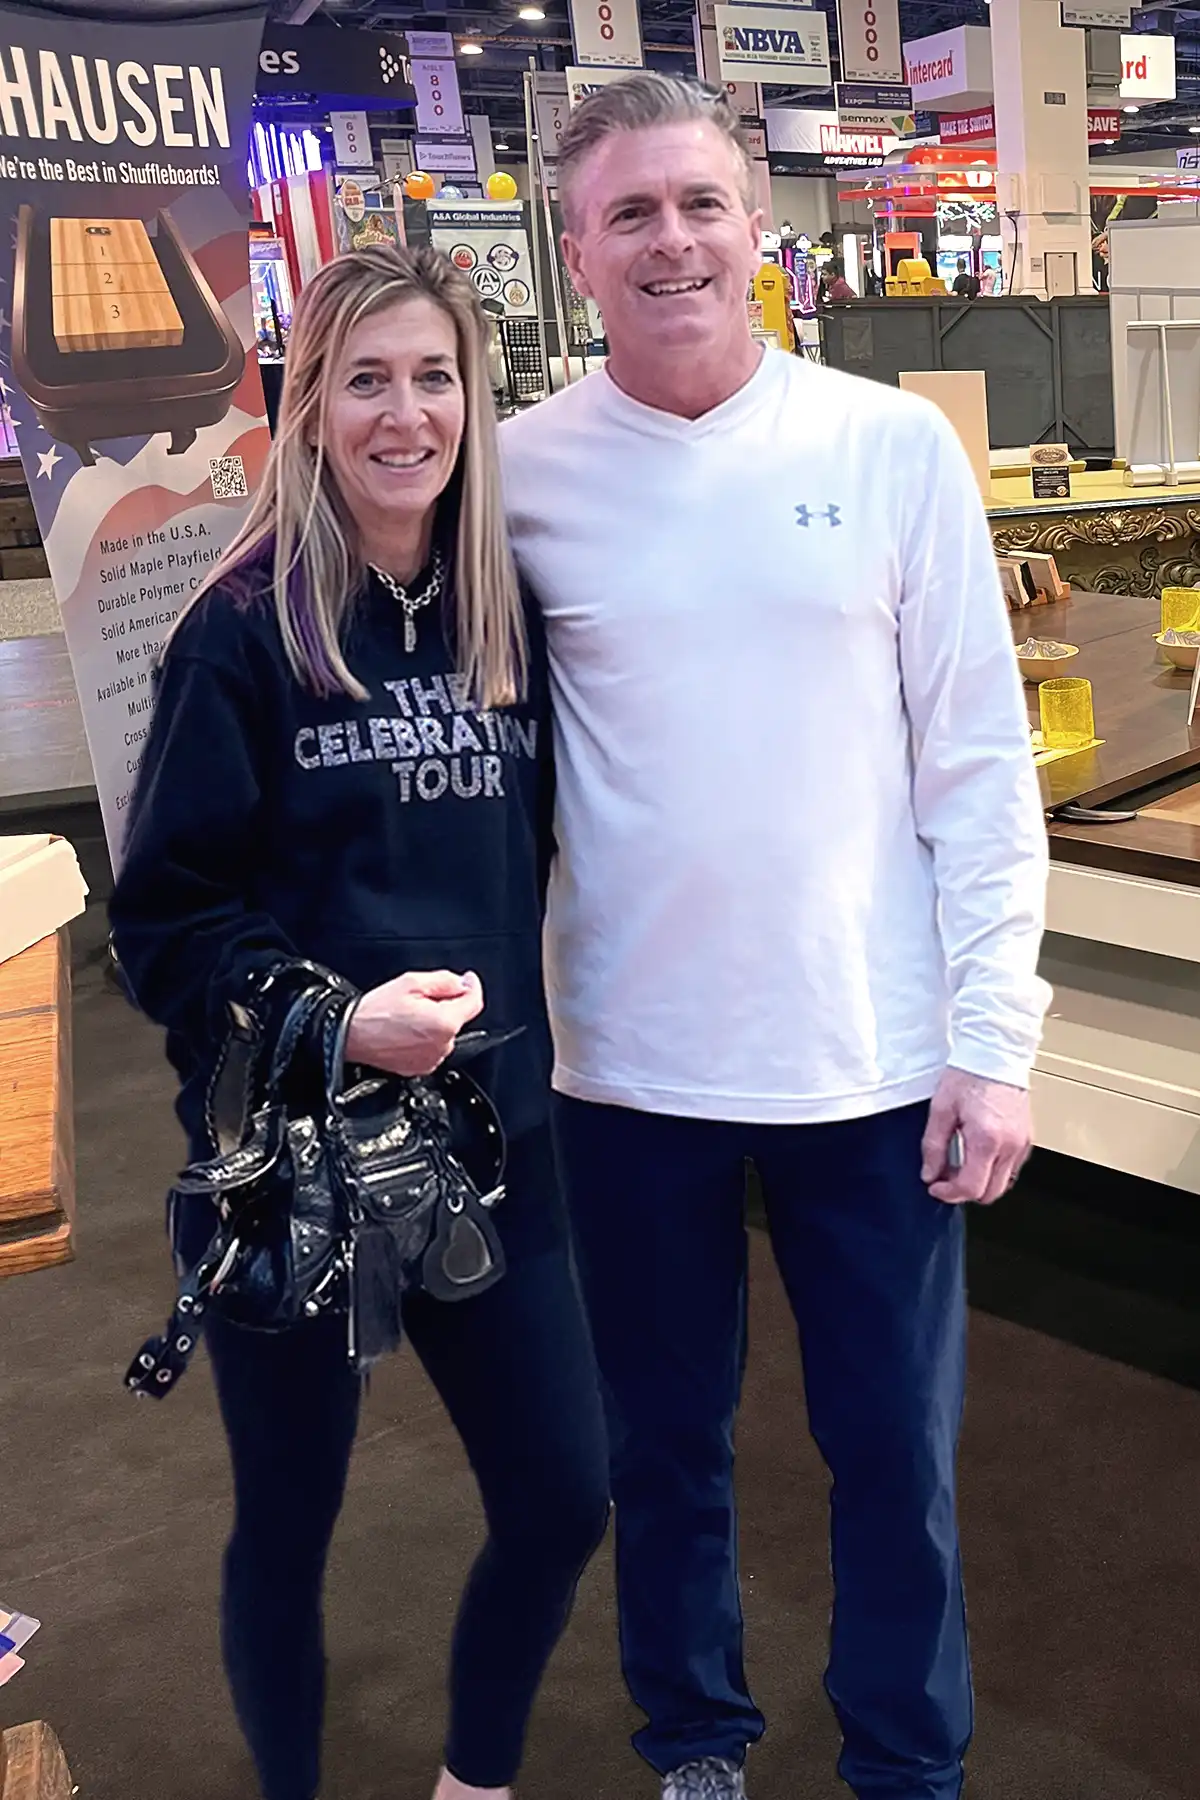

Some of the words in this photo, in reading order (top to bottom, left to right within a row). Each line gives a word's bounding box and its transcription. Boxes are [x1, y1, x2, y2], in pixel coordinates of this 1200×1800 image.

[733, 28, 805, 54] NBVA
[909, 51, 953, 85] intercard
[840, 115, 886, 124] semnox
[940, 120, 957, 136] MAKE
[957, 118, 968, 134] THE
[969, 114, 993, 133] SWITCH
[1087, 116, 1118, 132] SAVE
[38, 157, 64, 181] the
[65, 158, 100, 184] Best
[101, 161, 118, 183] in
[119, 161, 221, 186] Shuffleboards!
[823, 156, 868, 166] ADVENTURE
[868, 157, 883, 166] LAB
[452, 212, 479, 221] Global
[481, 212, 521, 221] Industries
[103, 272, 114, 284] 2
[110, 304, 121, 319] 3
[99, 538, 129, 556] Made
[132, 534, 144, 548] in
[147, 531, 166, 545] the
[170, 523, 212, 541] U.S.A.
[99, 564, 127, 584] Solid
[129, 557, 164, 576] Maple
[97, 592, 137, 614] Durable
[140, 582, 185, 602] Polymer
[101, 621, 126, 641] Solid
[129, 610, 179, 633] American
[116, 648, 140, 665] More
[97, 675, 135, 702] Available
[137, 671, 147, 685] in
[383, 672, 477, 718] THE
[124, 728, 148, 747] Cross
[391, 754, 506, 803] TOUR
